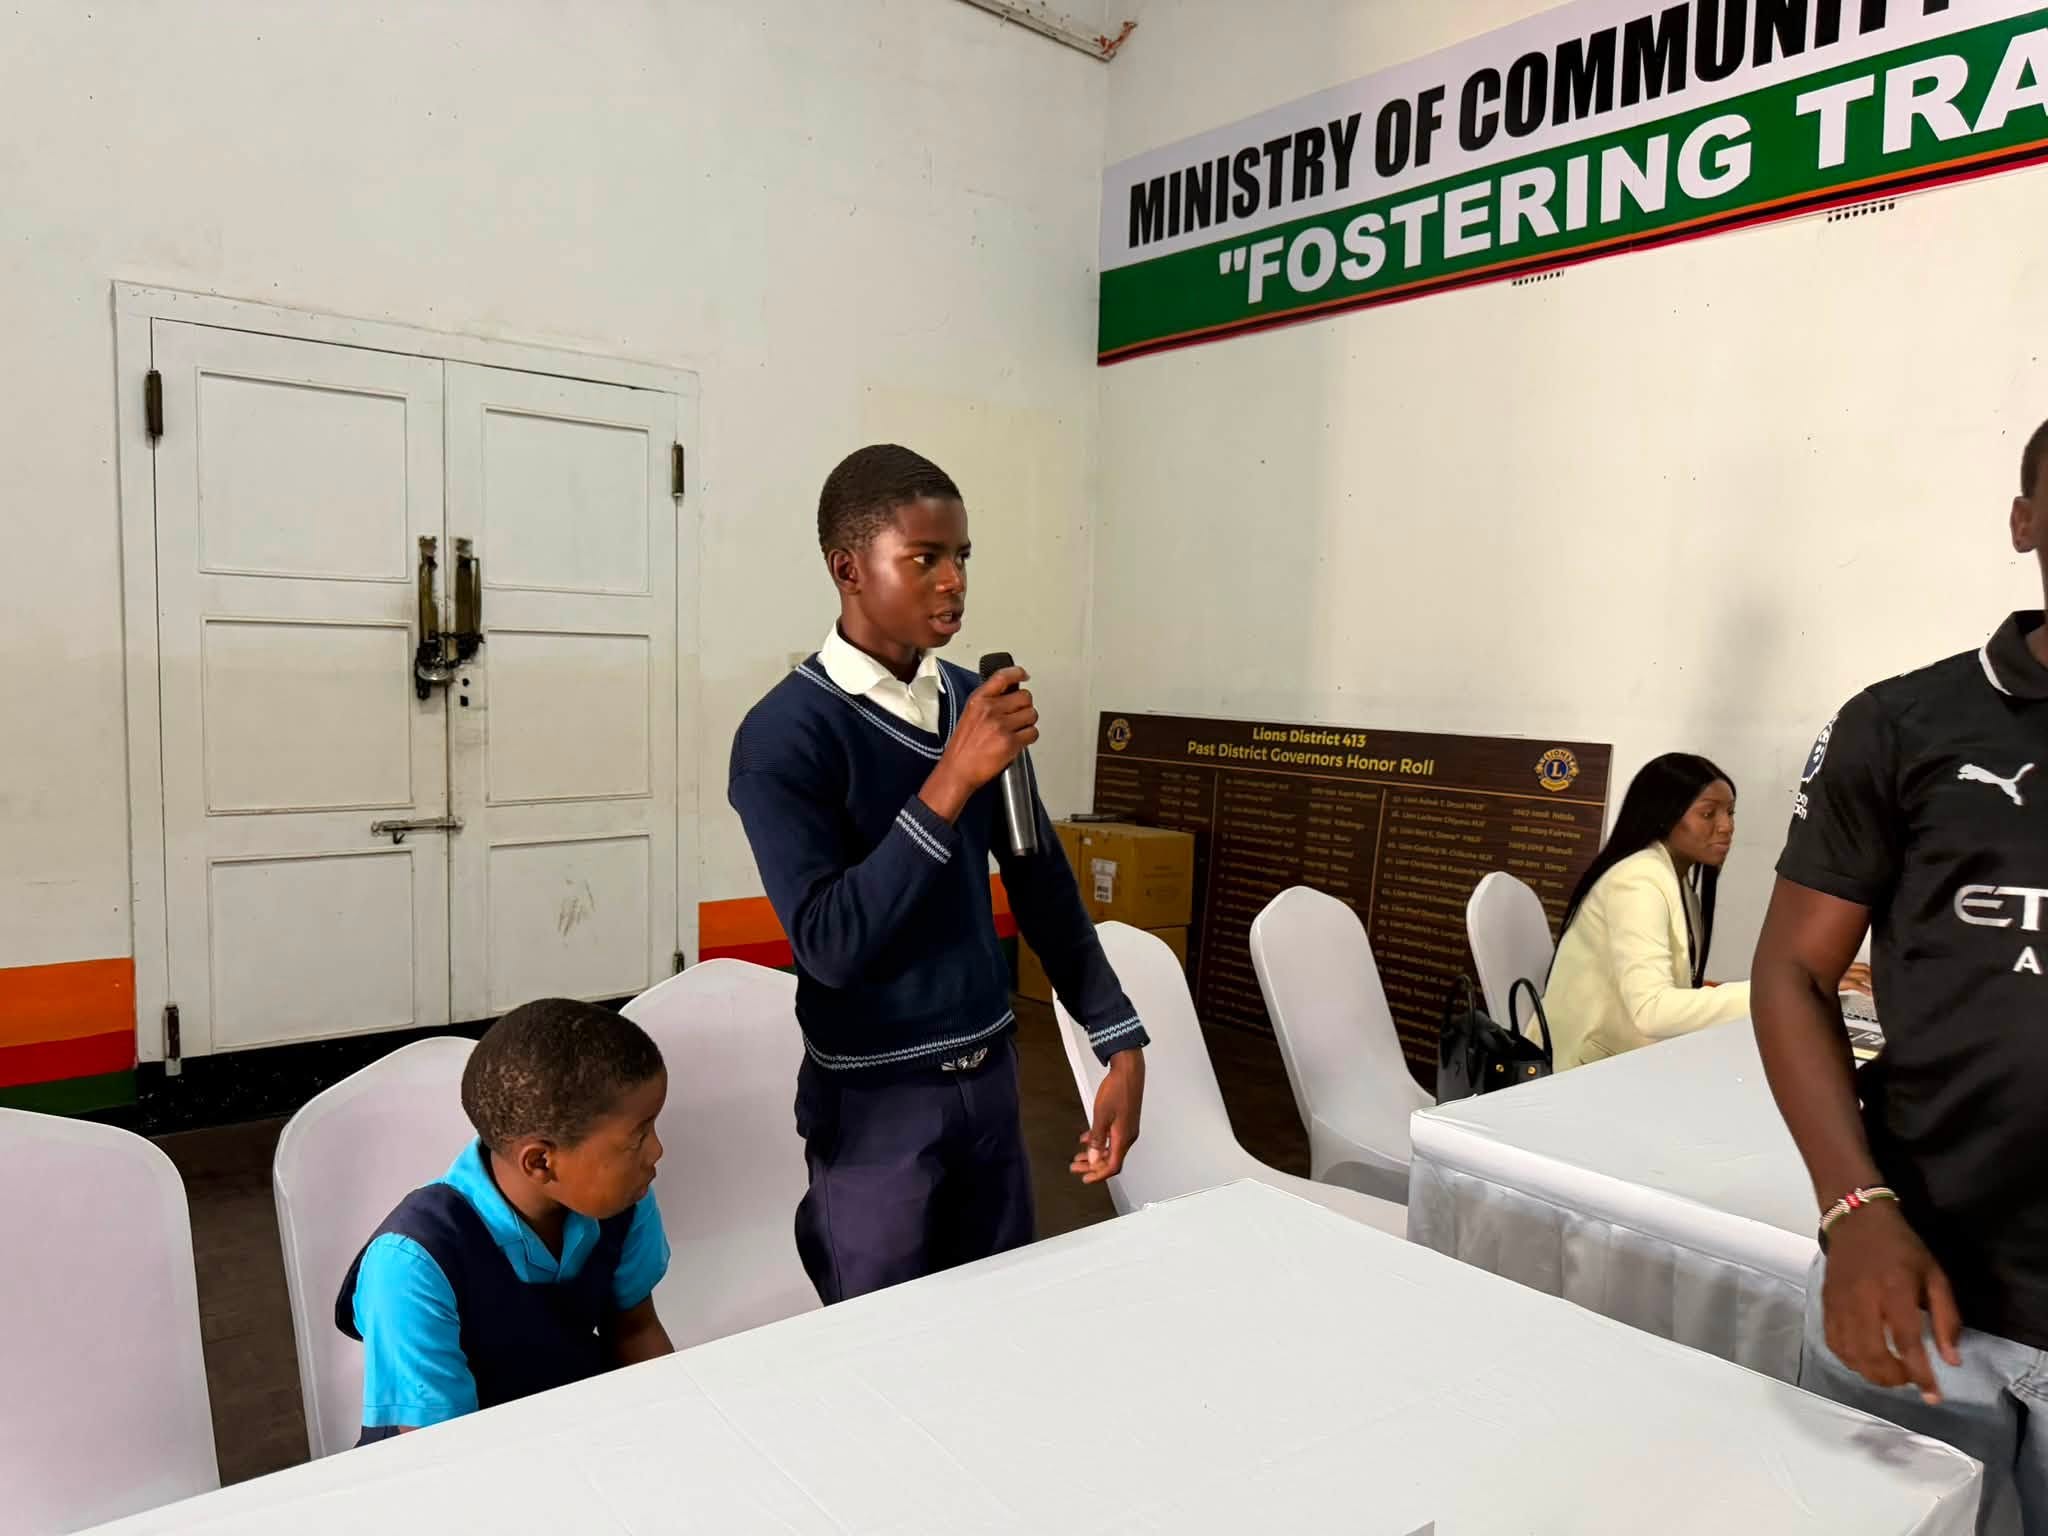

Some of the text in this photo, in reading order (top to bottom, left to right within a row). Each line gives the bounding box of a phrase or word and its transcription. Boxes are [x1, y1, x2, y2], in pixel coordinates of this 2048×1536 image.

[1129, 0, 1950, 249] MINISTRY OF COMMUN
[1219, 27, 2048, 304] "FOSTERING TRA
[1253, 727, 1367, 749] Lions District 413
[1188, 741, 1435, 776] Past District Governors Honor Roll
[2012, 946, 2043, 975] A
